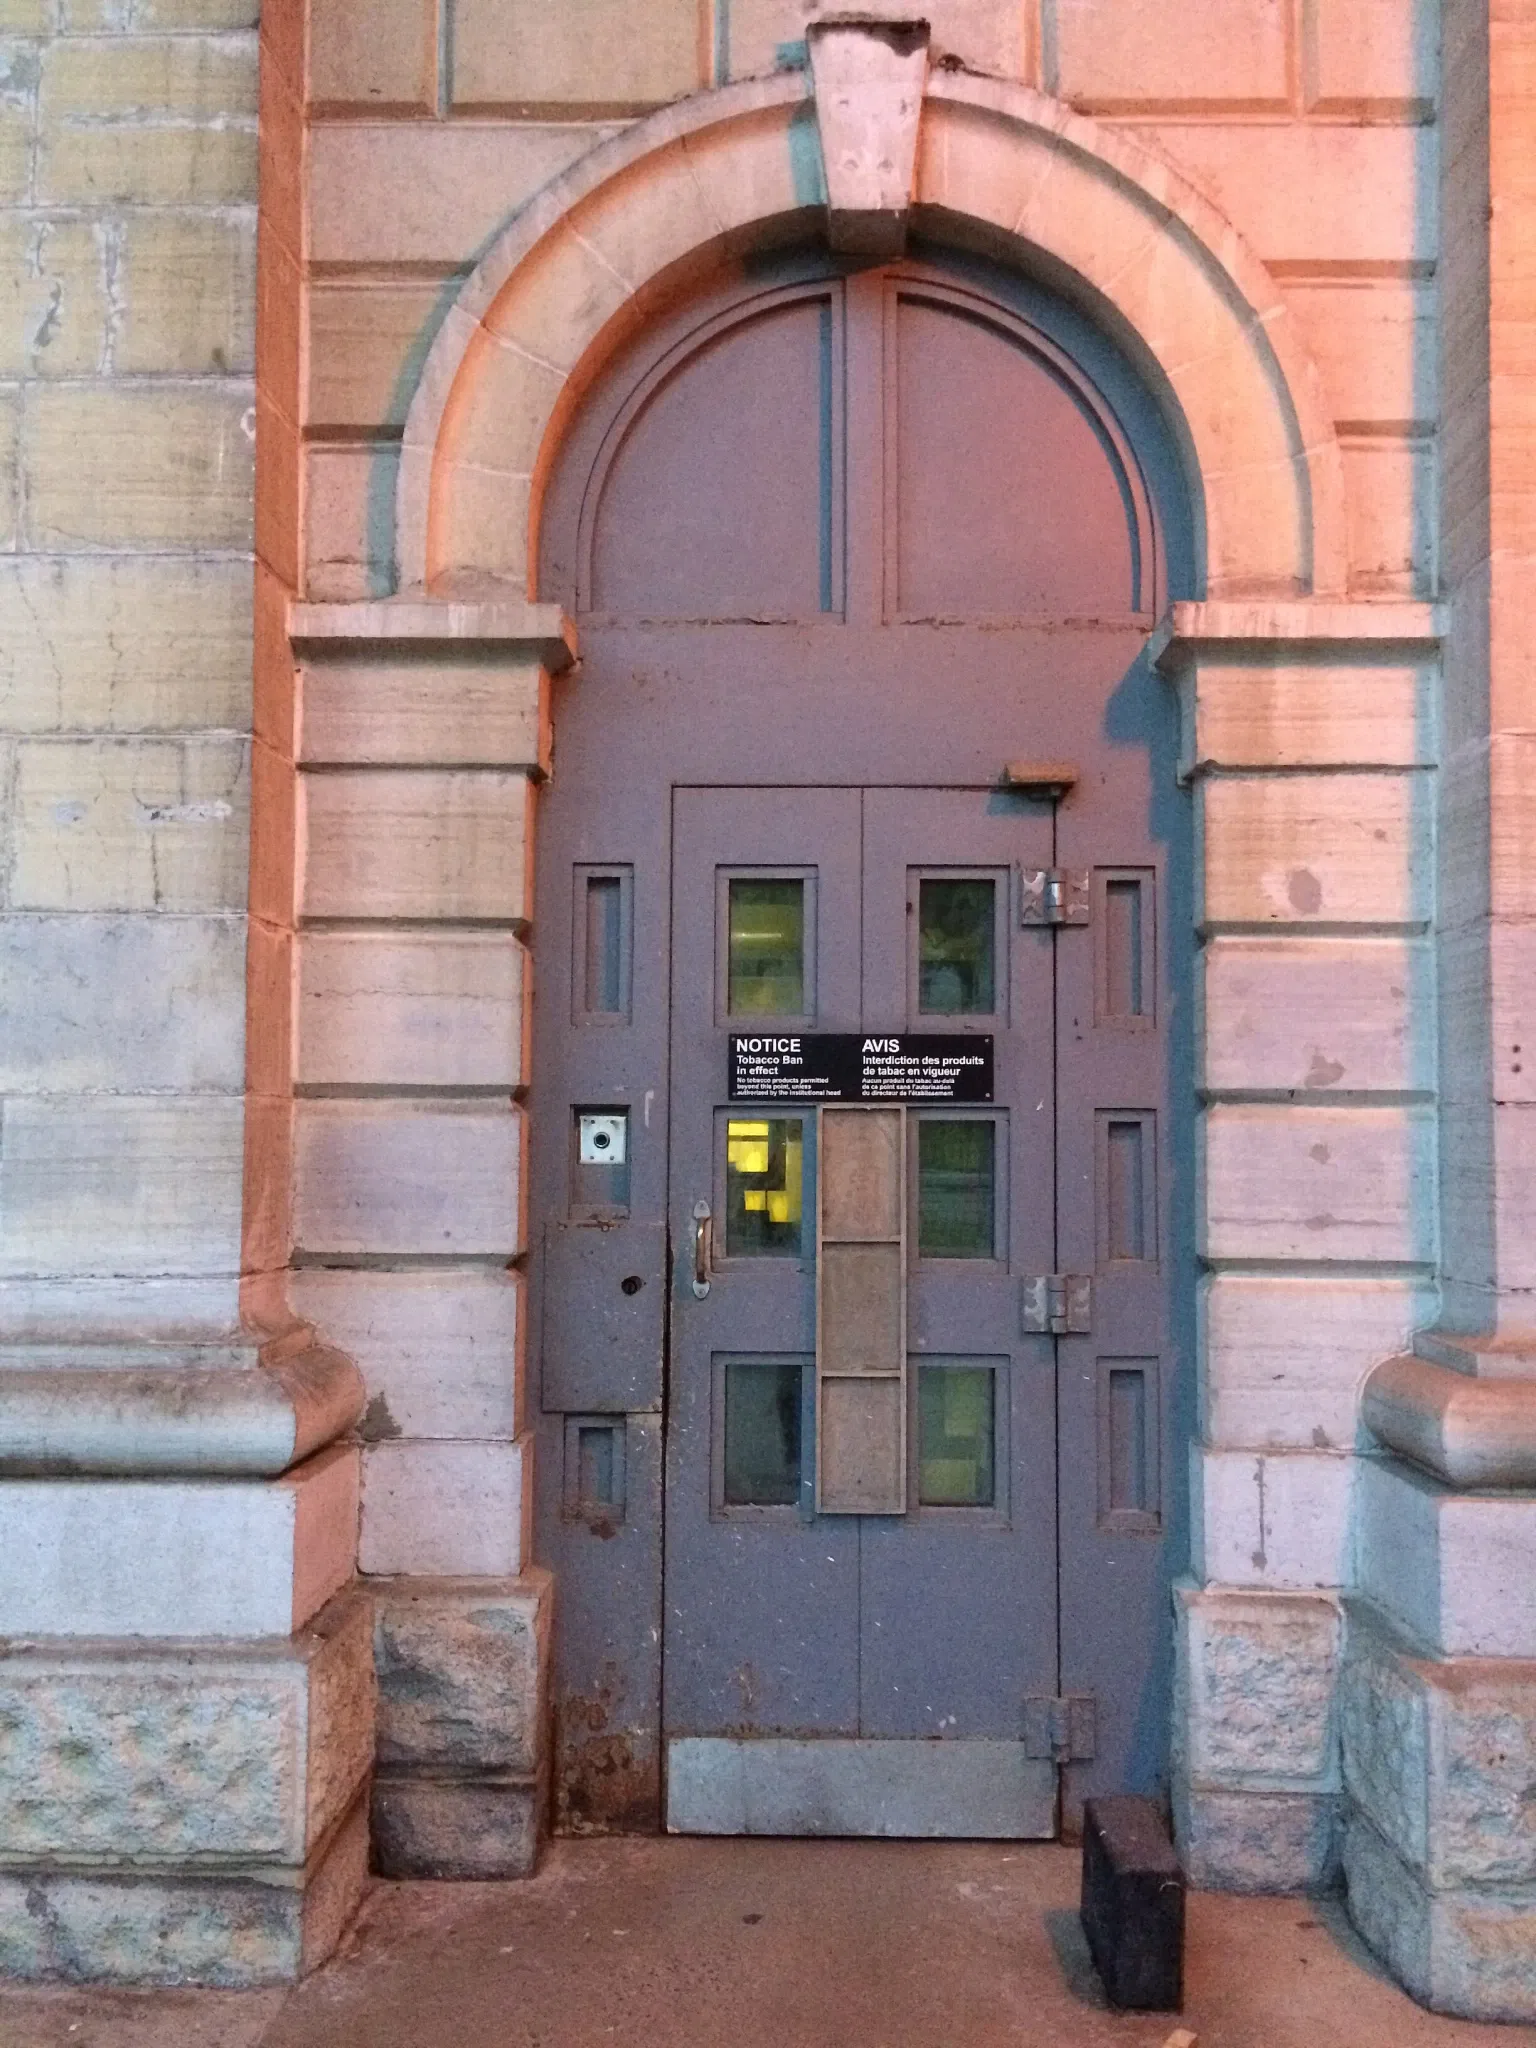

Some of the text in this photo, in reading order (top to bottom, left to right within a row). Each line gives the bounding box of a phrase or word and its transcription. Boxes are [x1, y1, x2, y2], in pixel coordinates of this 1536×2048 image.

[736, 1038, 801, 1053] NOTICE
[862, 1038, 900, 1053] AVIS
[736, 1055, 803, 1065] Tobacco Ban
[862, 1056, 985, 1067] Interdiction des produits
[736, 1066, 779, 1075] in effect
[862, 1067, 961, 1078] de tabac en vigueur
[772, 1077, 799, 1085] products
[800, 1077, 829, 1085] permitted
